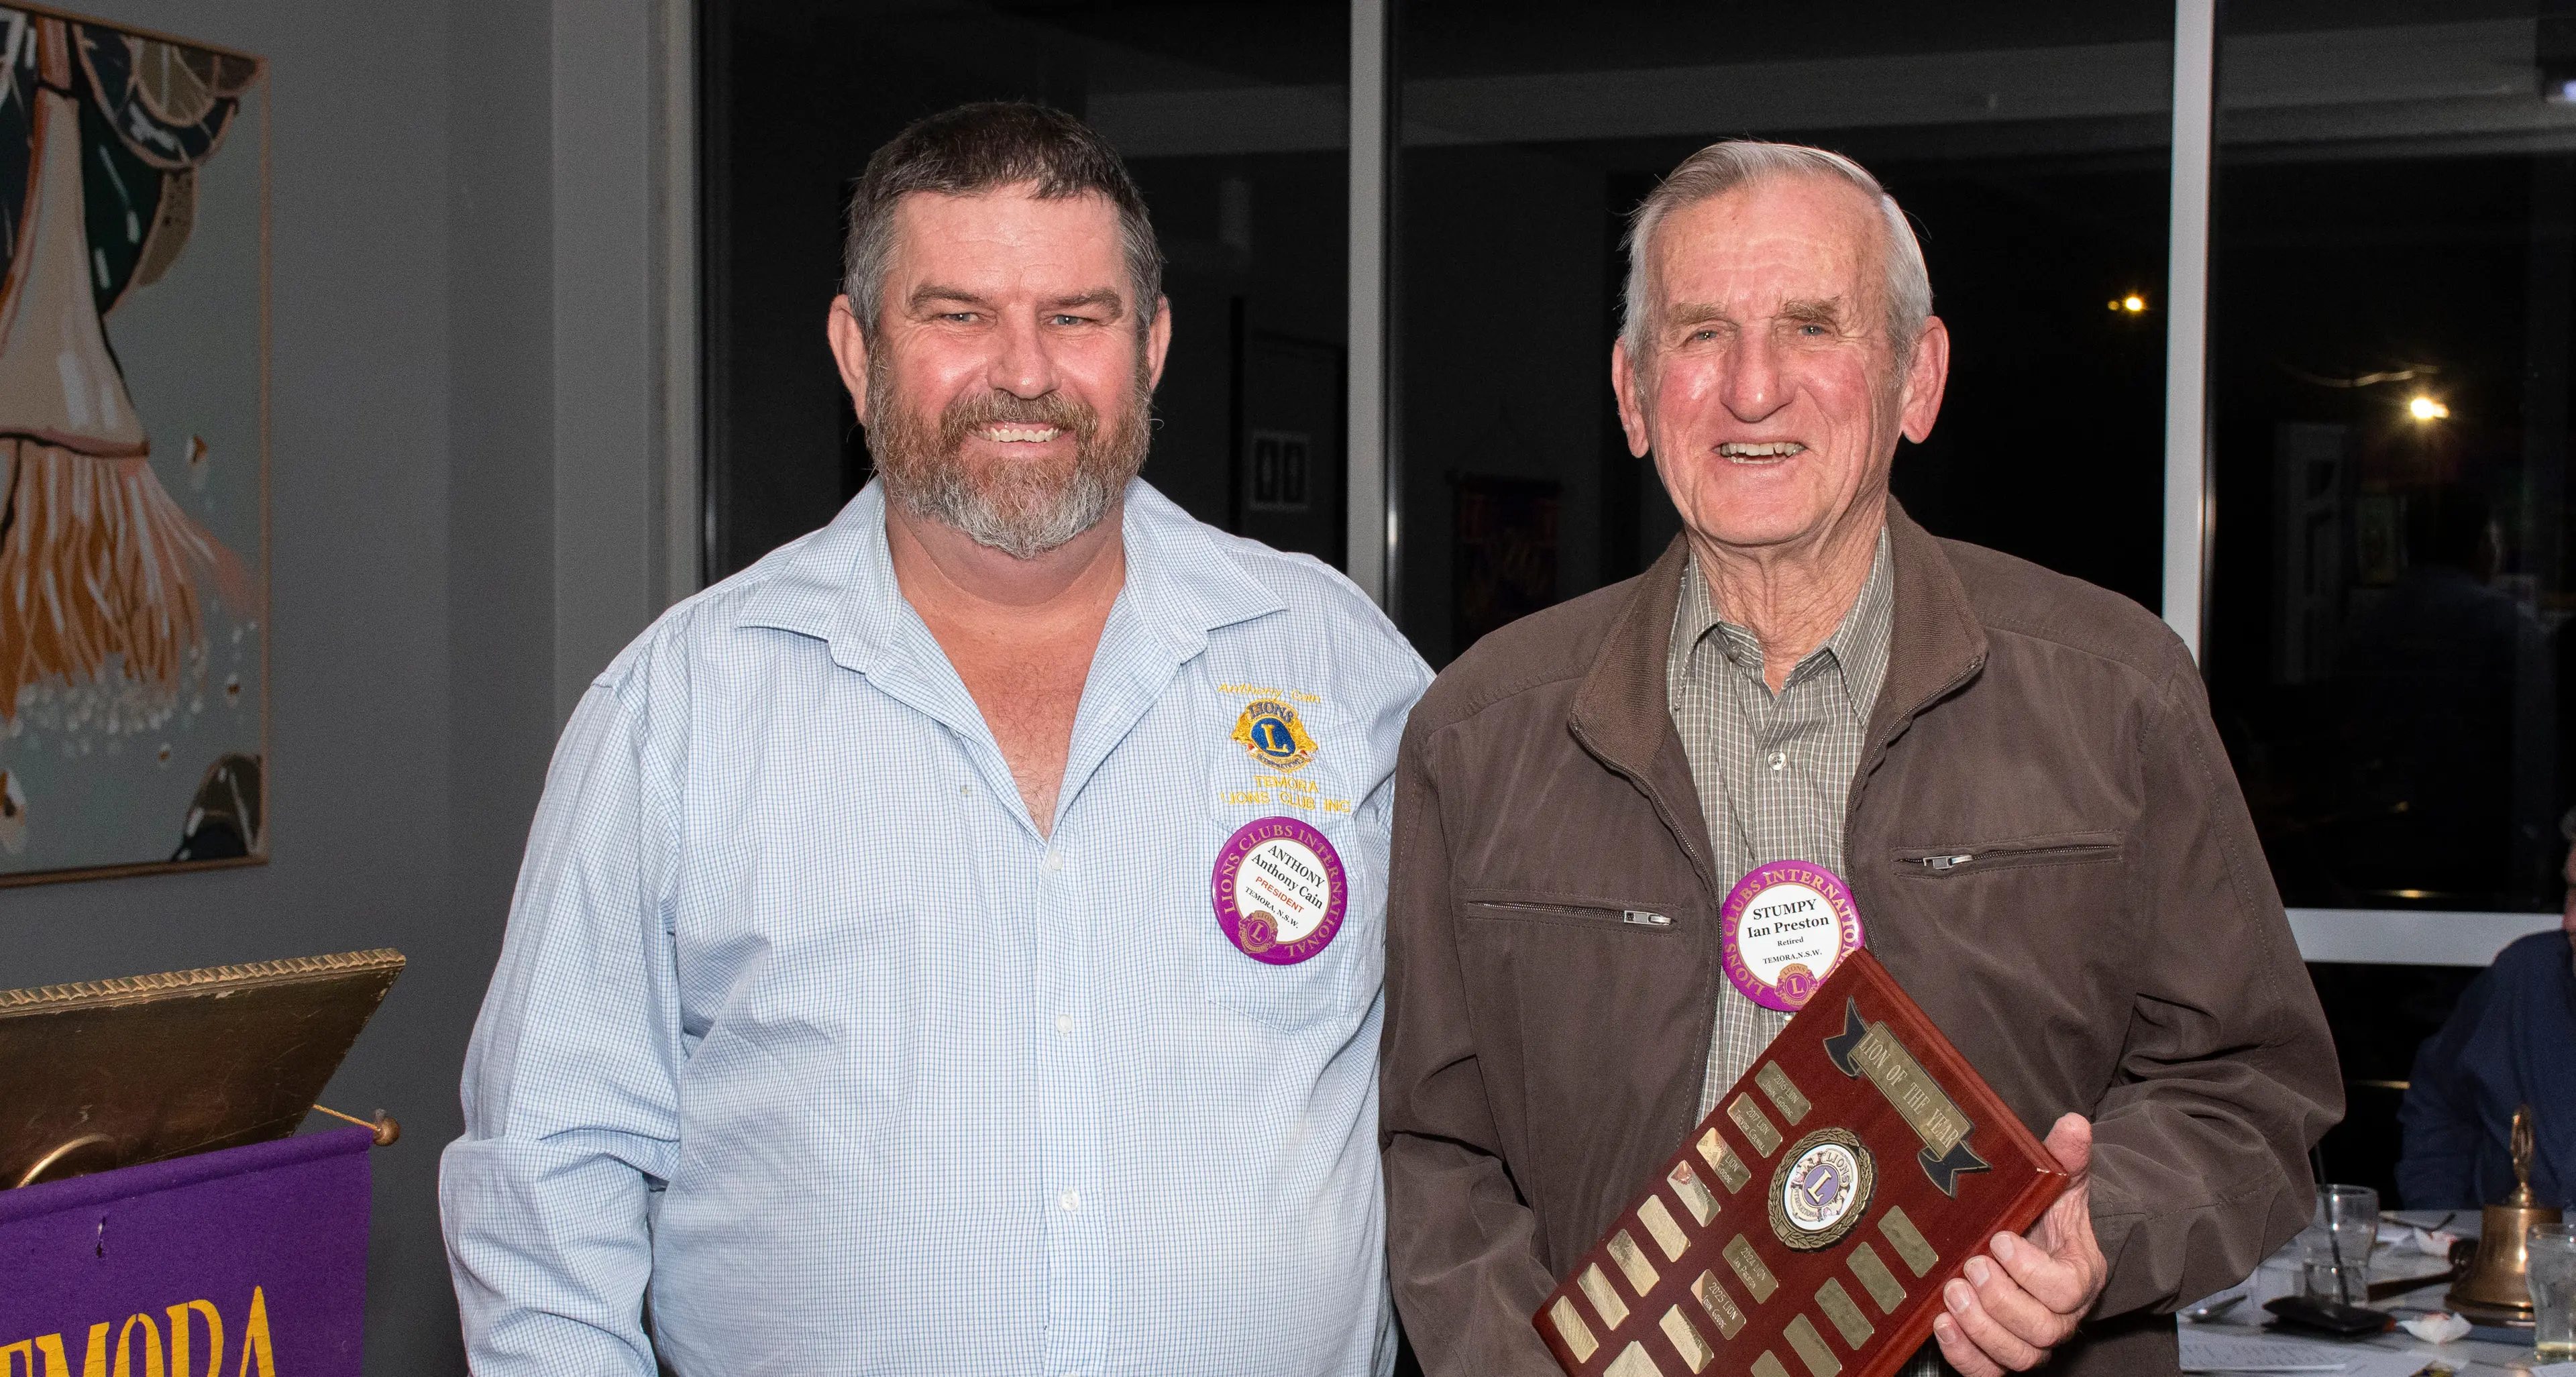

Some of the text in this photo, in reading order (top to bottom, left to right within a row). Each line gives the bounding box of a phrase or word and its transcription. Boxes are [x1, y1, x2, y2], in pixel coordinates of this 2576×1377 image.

[1217, 682, 1321, 704] Anthony Cain
[1248, 702, 1294, 723] LIONS
[1261, 724, 1289, 753] L
[1253, 775, 1319, 793] TEMORA
[1220, 791, 1350, 813] LIONS CLUB INC
[1268, 845, 1326, 888] ANTHONY
[1222, 824, 1342, 956] LIONS CLUBS INTERNATIONAL
[1251, 854, 1324, 910] Anthony Cain
[1255, 876, 1304, 914] PRESIDENT
[1245, 887, 1299, 929] TEMORA, N.S.W.
[1753, 899, 1817, 920] STUMPY
[1250, 922, 1264, 942] L
[1725, 869, 1856, 997] LIONS CLUBS INTERNATION
[1747, 917, 1829, 938] Ian Preston
[1777, 936, 1804, 946] Retired
[1783, 966, 1805, 975] LIONS
[1790, 978, 1805, 995] L
[1785, 1088, 1799, 1104] LION
[1858, 1033, 1959, 1149] LION OF THE YEAR
[1746, 1107, 1770, 1135] 2017 LION
[1725, 1154, 1739, 1172] LION
[1826, 1152, 1850, 1182] LIONS
[1807, 1168, 1833, 1205] L
[1740, 1248, 1768, 1281] 2024 LION
[1709, 1282, 1738, 1320] 2025 LION
